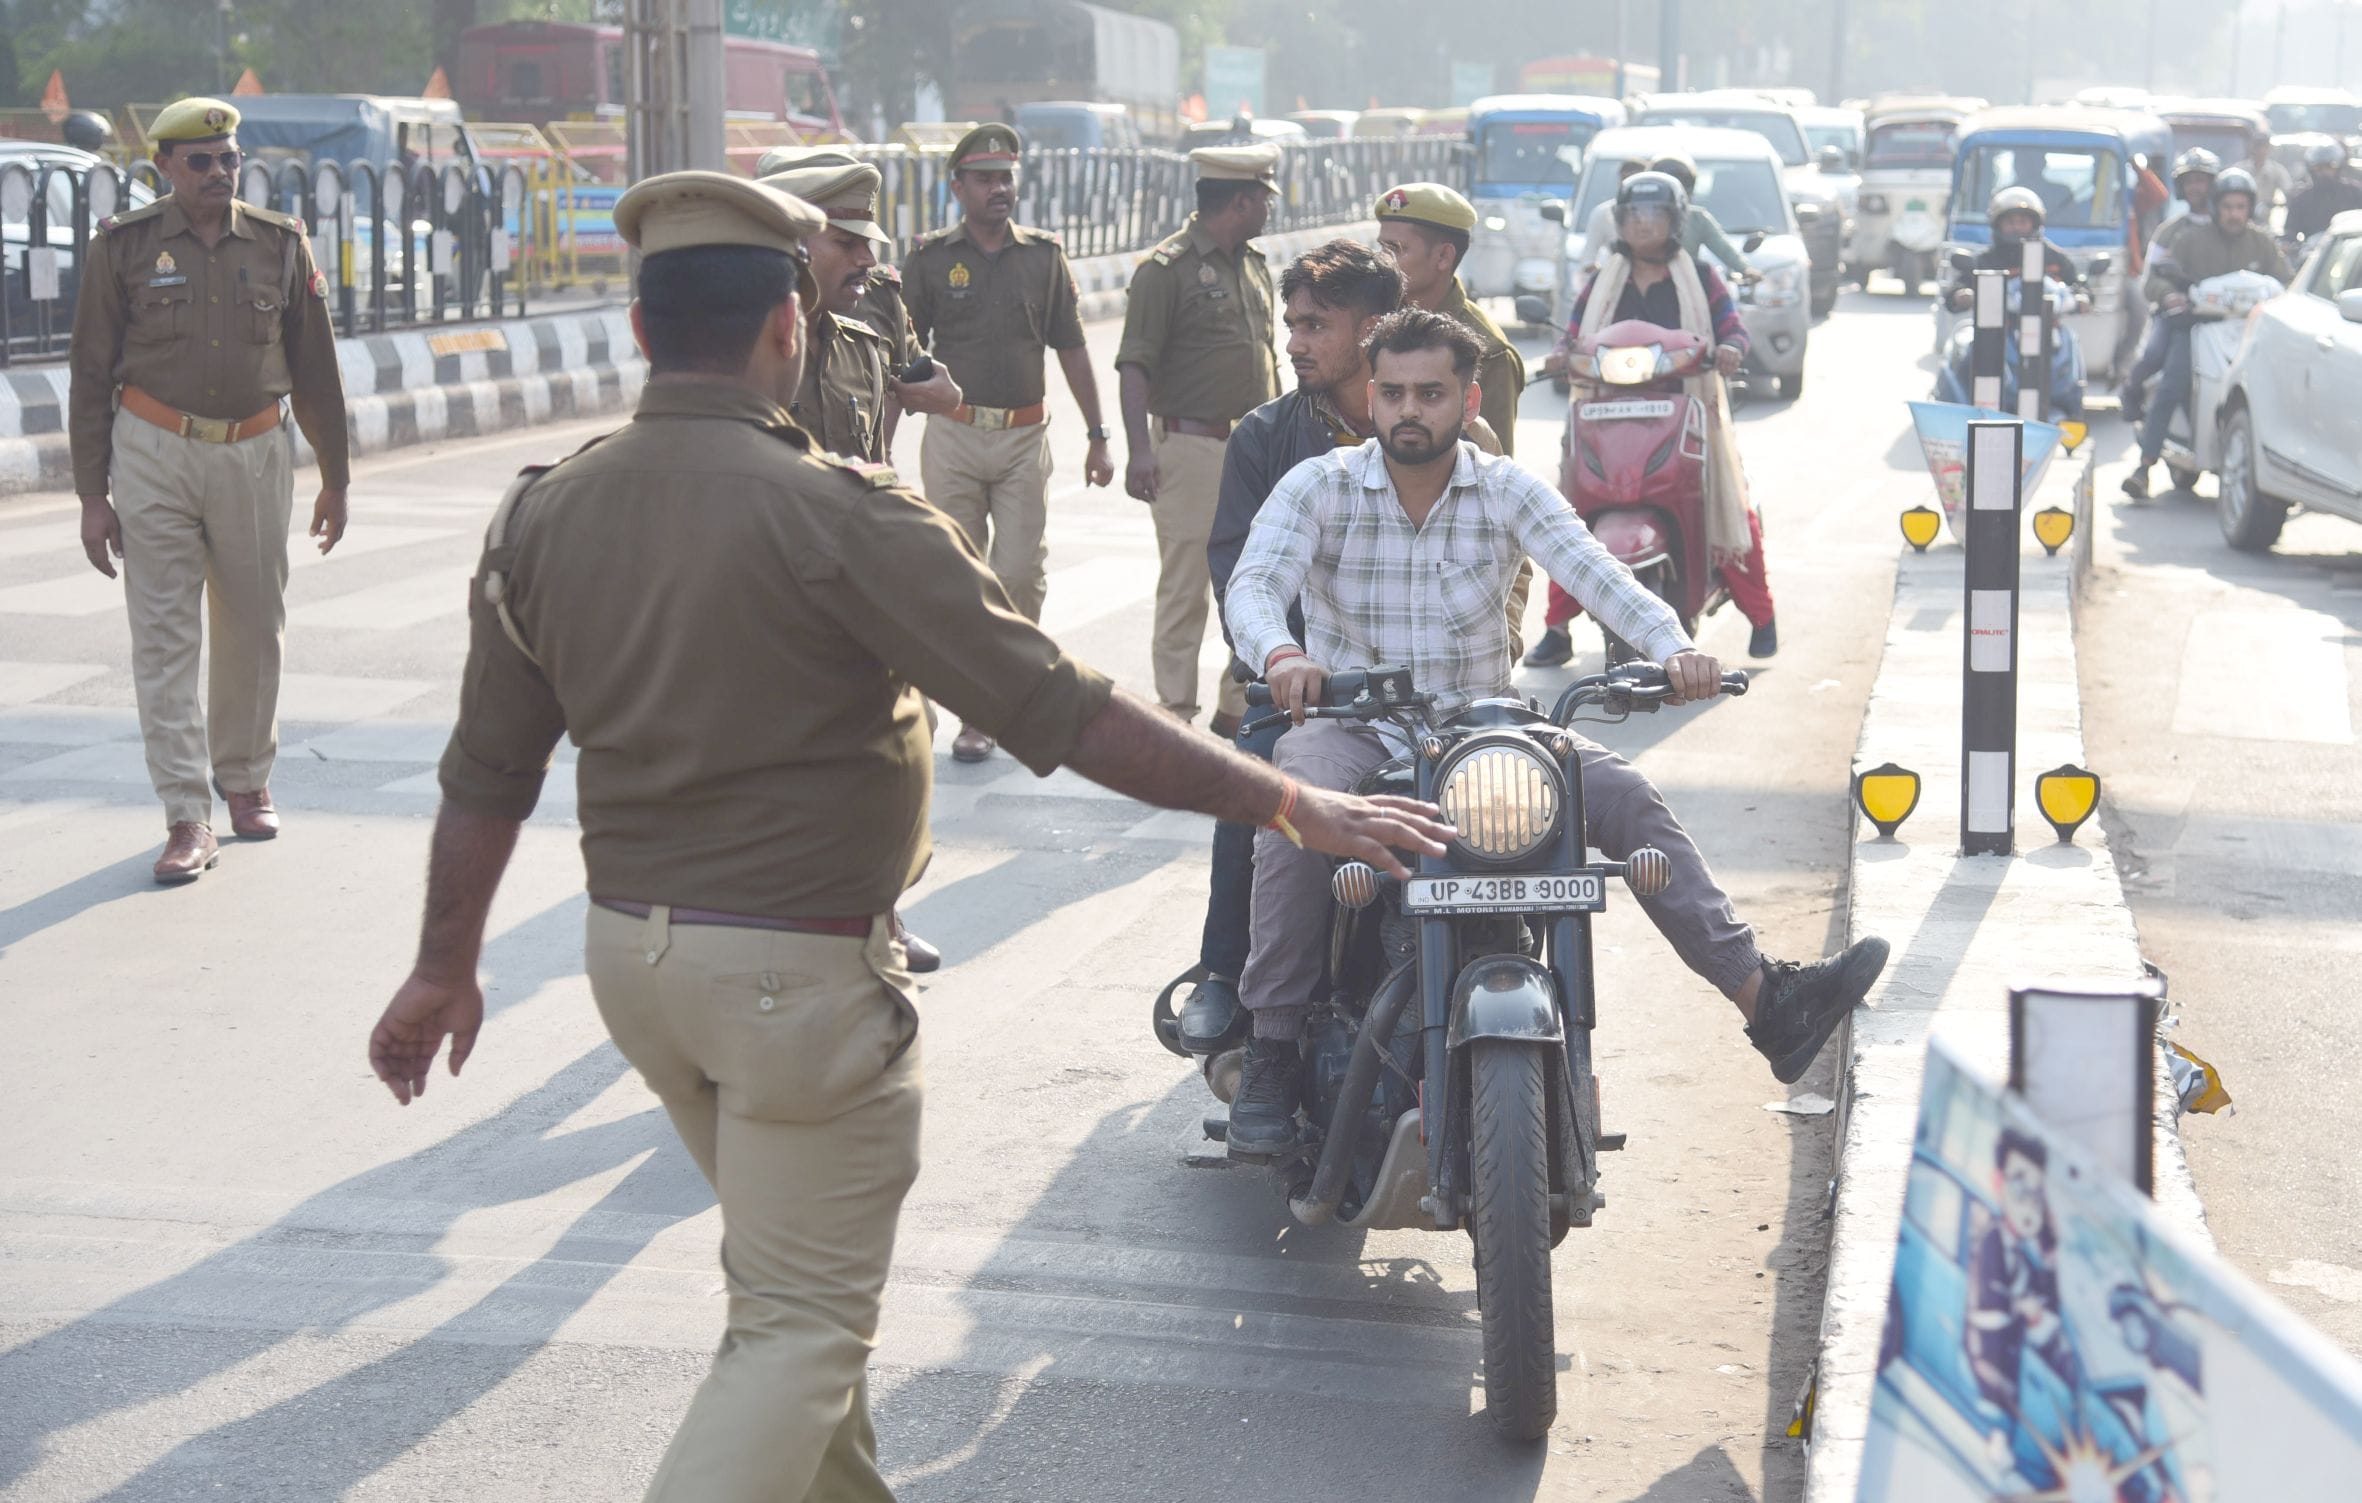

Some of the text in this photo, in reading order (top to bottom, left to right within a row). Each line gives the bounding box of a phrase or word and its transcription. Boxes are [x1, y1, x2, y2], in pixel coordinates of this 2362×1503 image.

[1430, 879, 1595, 902] UP 43BB 9000
[1456, 906, 1494, 914] MOTORS
